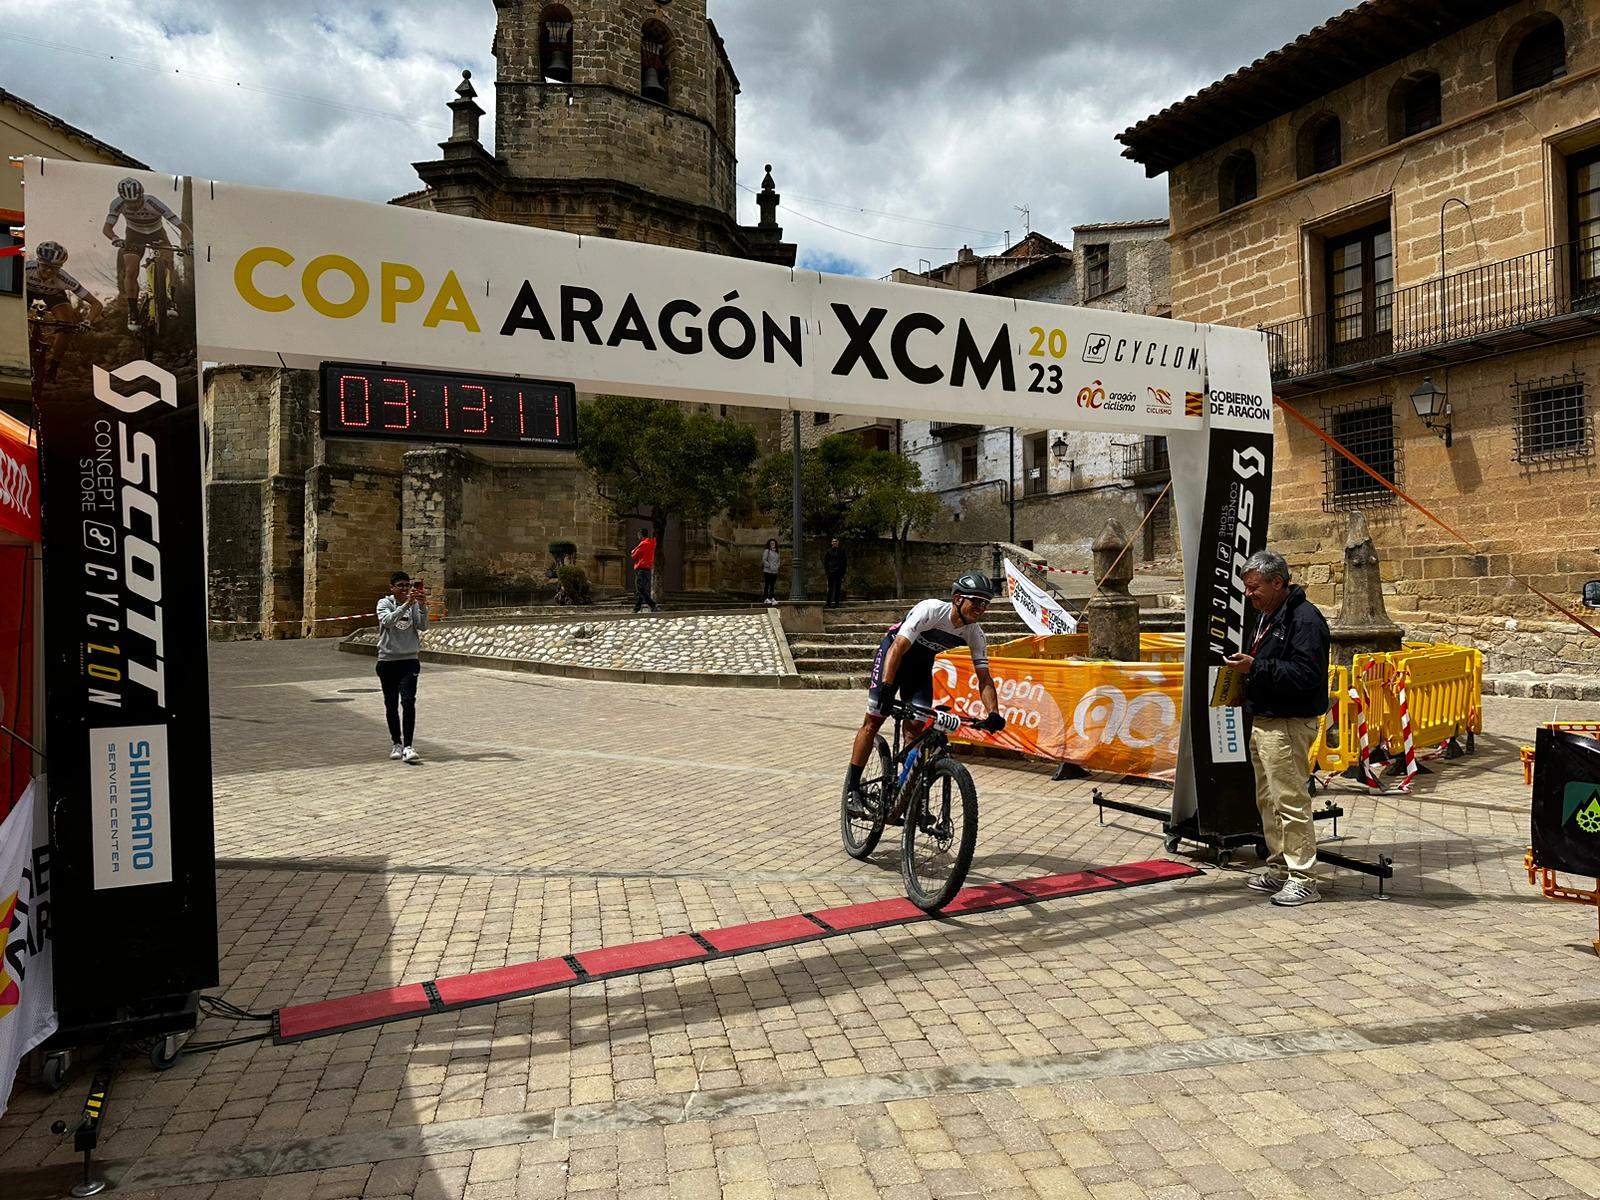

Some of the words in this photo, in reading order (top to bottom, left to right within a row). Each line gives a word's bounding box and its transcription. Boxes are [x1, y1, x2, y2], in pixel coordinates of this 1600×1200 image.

[234, 246, 481, 333] COPA
[500, 279, 803, 368] ARAGÓN
[830, 303, 1016, 392] XCM
[1028, 326, 1068, 360] 20
[1115, 339, 1200, 371] CYCLON
[1027, 362, 1064, 395] 23
[340, 375, 560, 438] 03:13:11
[1103, 401, 1136, 412] ciclismo
[1109, 392, 1137, 403] aragón
[1146, 407, 1173, 416] CICLISMO
[1210, 390, 1263, 407] GOBIERNO
[1210, 403, 1225, 416] DE
[1227, 404, 1270, 421] ARAGON
[94, 420, 116, 511] CONCEPT
[79, 458, 97, 512] STORE
[1218, 505, 1229, 537] STORE
[1226, 481, 1238, 537] CONCEPT
[118, 421, 166, 708] SCOTT
[869, 648, 884, 689] KENZA
[938, 711, 960, 732] 300
[108, 743, 117, 805] SERVICE
[129, 740, 154, 871] SHIMANO
[110, 808, 120, 873] CENTER
